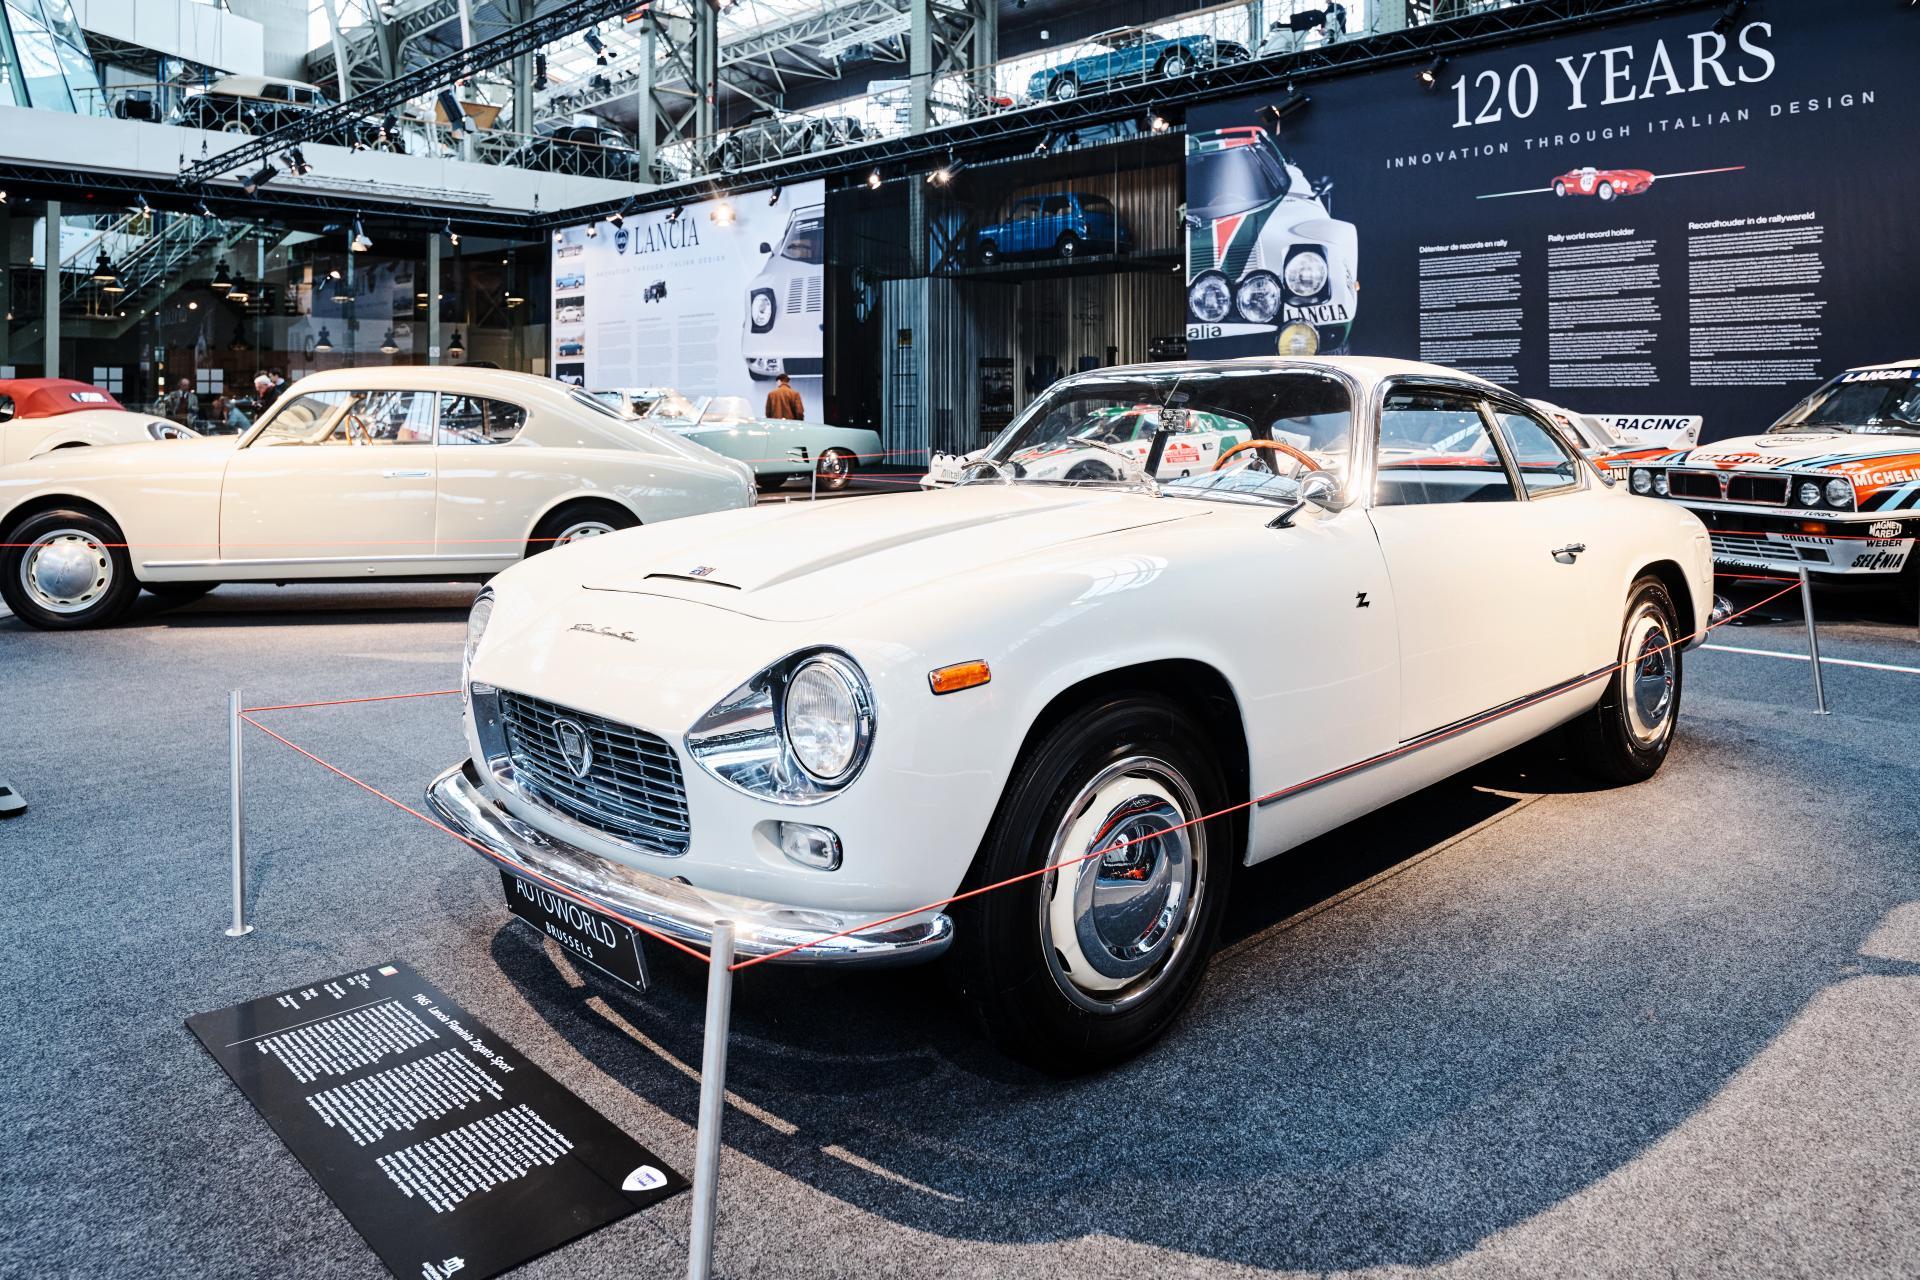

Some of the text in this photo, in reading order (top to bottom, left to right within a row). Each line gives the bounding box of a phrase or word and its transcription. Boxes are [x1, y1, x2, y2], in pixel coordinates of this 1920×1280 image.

[1451, 21, 1776, 128] 120 YEARS
[1386, 91, 1876, 169] INNOVATION THROUGH ITALIAN DESIGN
[1688, 212, 1816, 230] Recordhouder in de rallywereld
[635, 217, 699, 255] LANCIA
[1547, 228, 1635, 243] Rally world record holder
[1286, 303, 1349, 323] LANCIA
[1188, 324, 1222, 339] alia
[1841, 369, 1912, 383] LANCIA
[1615, 418, 1690, 431] RACING
[941, 468, 961, 481] Alital
[1866, 540, 1903, 548] WEBER
[1355, 591, 1370, 609] Z
[516, 878, 616, 950] AUTOWORLD
[545, 921, 594, 960] BRUSSELS
[427, 1006, 451, 1023] Lancia
[445, 1020, 474, 1042] Flaminia
[468, 1038, 495, 1059] Zagato
[490, 1056, 515, 1074] Sport
